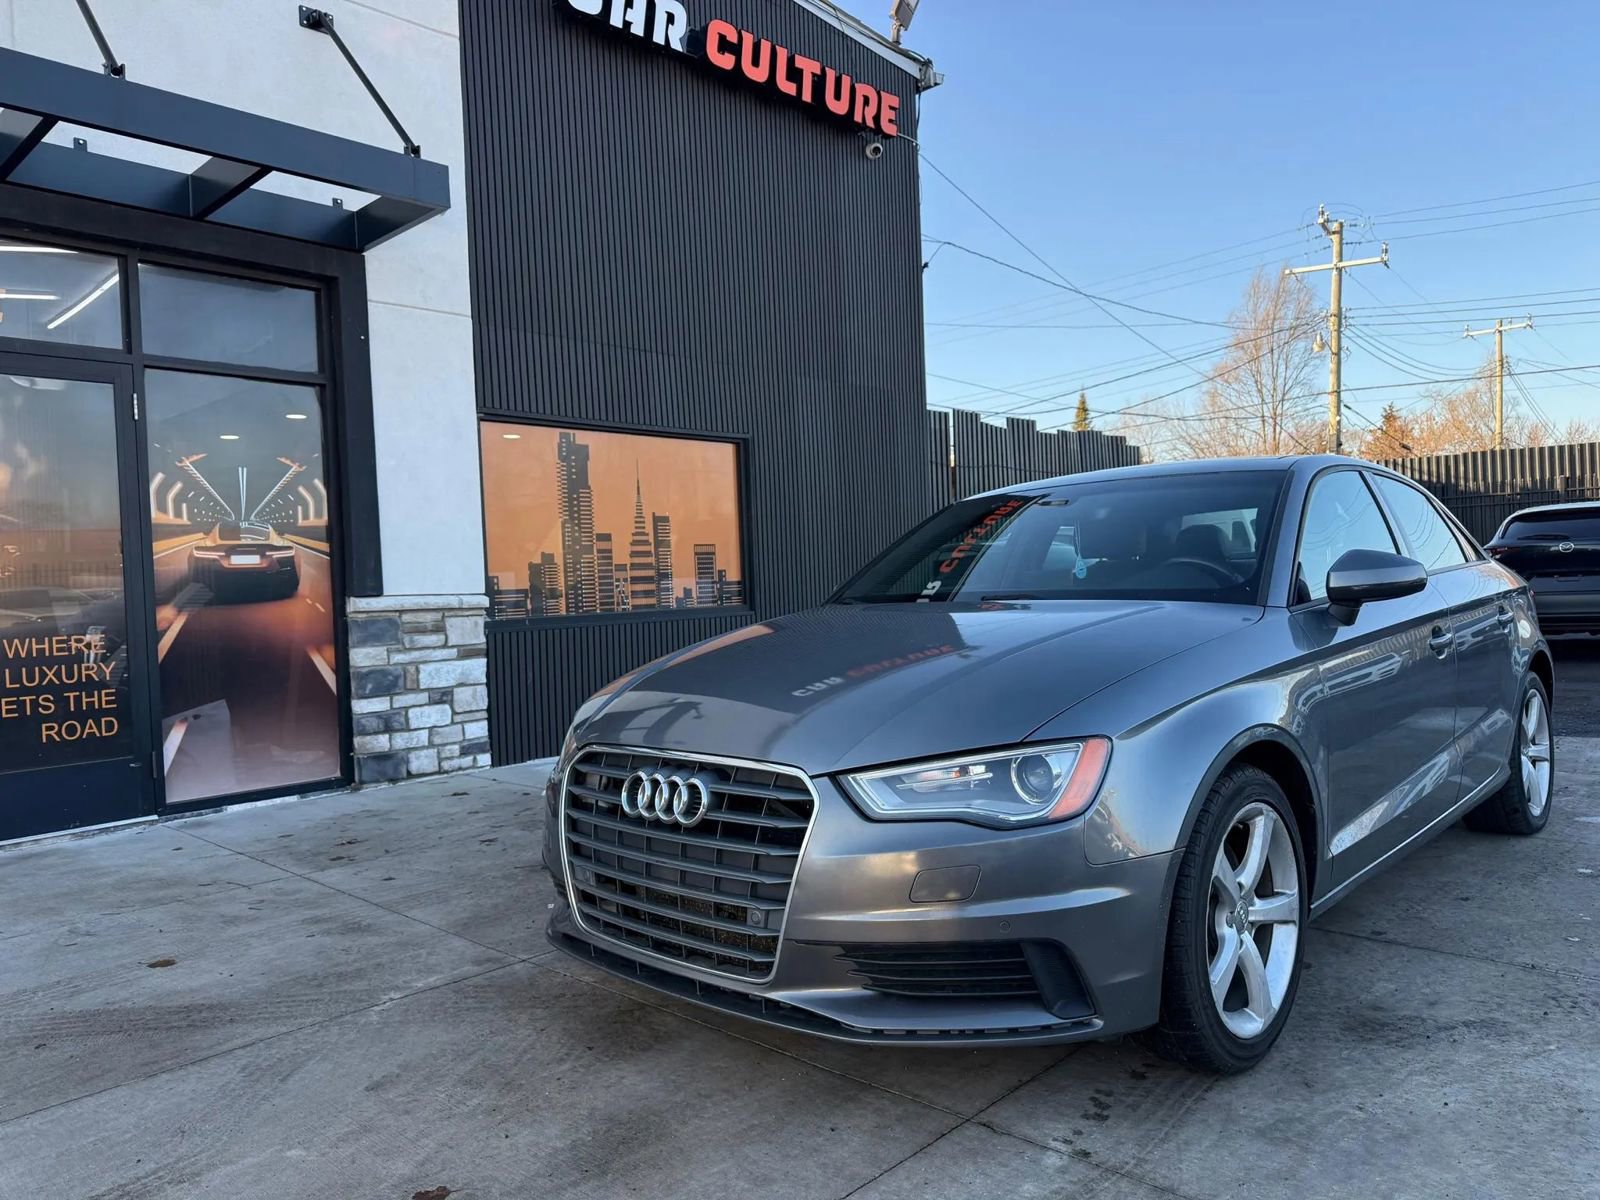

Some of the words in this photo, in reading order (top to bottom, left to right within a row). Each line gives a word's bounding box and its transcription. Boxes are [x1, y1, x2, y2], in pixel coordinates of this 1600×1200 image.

[706, 18, 900, 137] CULTURE
[3, 634, 107, 659] WHERE
[5, 661, 116, 689] LUXURY
[64, 689, 118, 712] THE
[41, 717, 119, 743] ROAD
